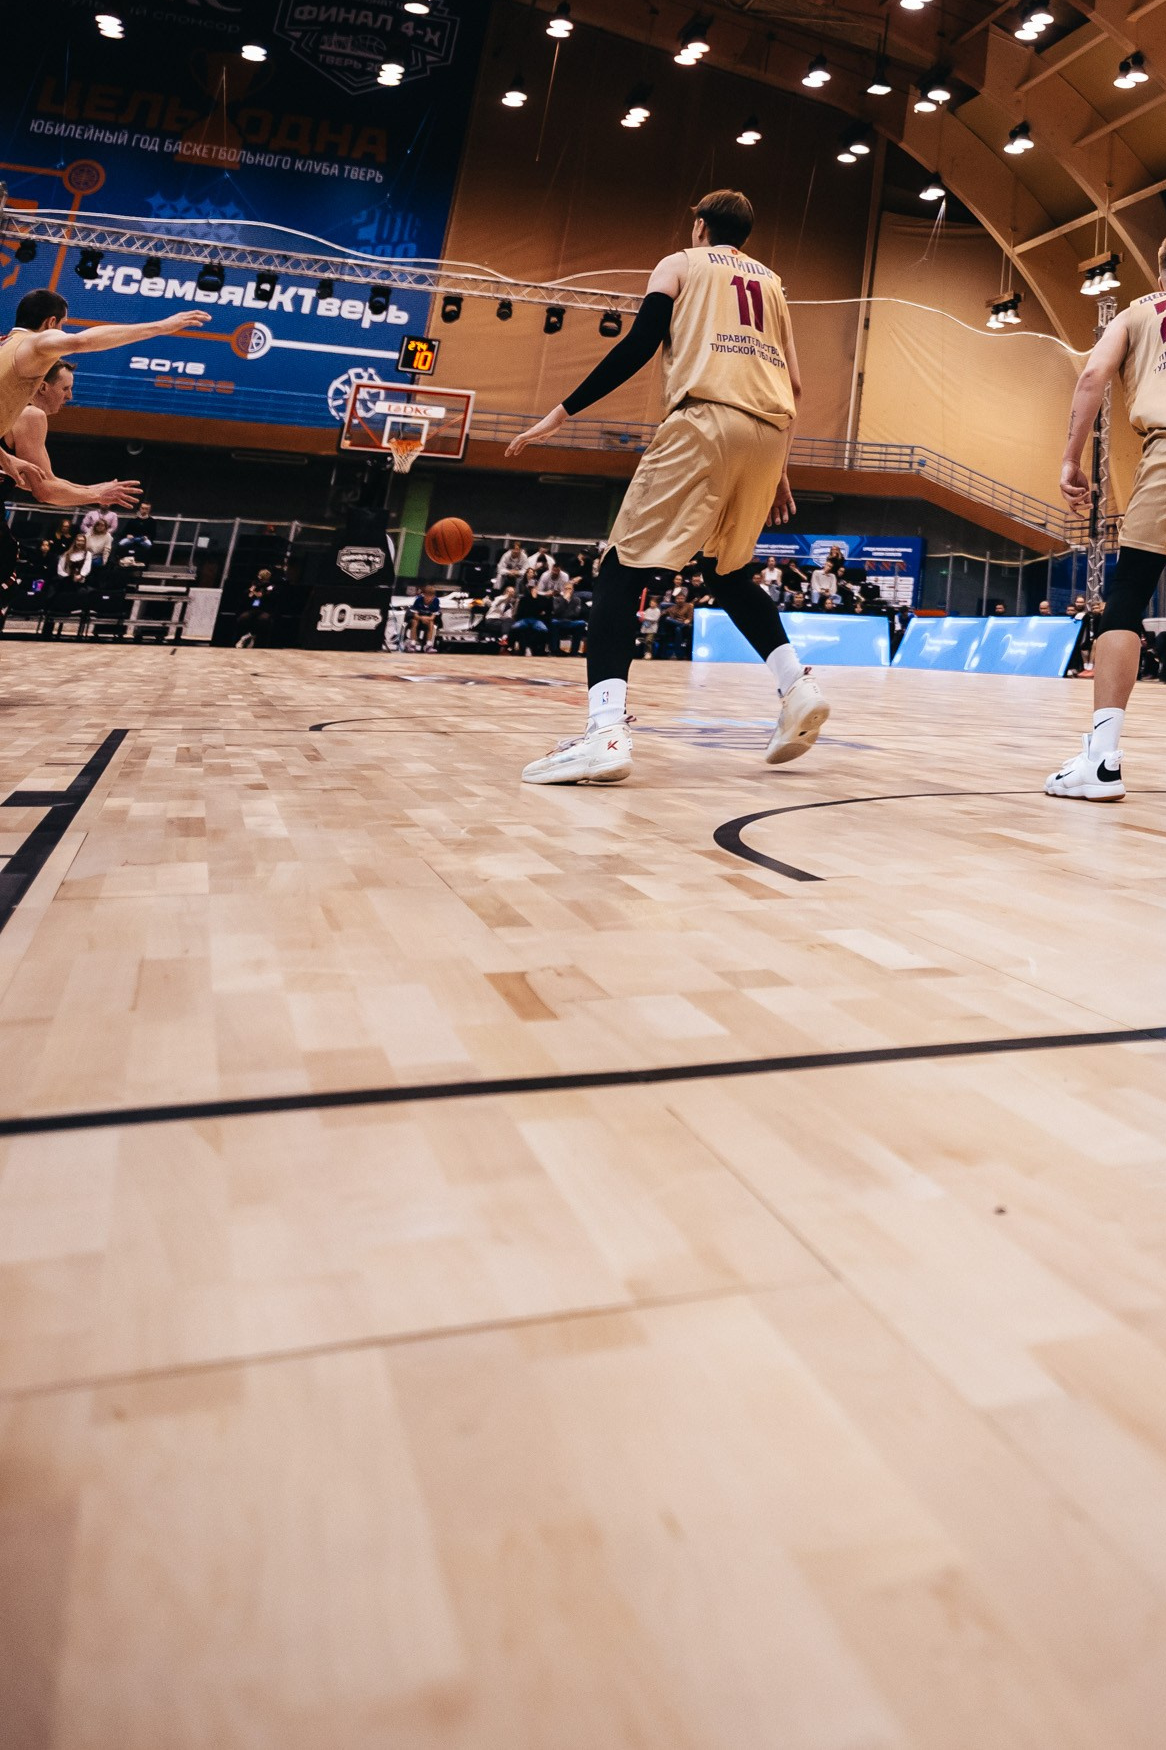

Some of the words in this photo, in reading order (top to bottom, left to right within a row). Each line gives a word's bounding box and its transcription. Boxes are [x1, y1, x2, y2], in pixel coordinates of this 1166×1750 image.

[294, 4, 394, 31] ФИНАЛ
[36, 74, 200, 132] ЦЕЛЬ
[237, 108, 388, 164] ОДНА
[29, 118, 129, 146] ЮБИЛЕЙНЫЙ
[131, 133, 160, 153] ГОД
[163, 139, 291, 170] БАСКЕТБОЛЬНОГО
[294, 158, 340, 178] КЛУБА
[343, 165, 384, 184] ТВЕРЬ
[708, 253, 773, 279] АНТИПОВ
[730, 275, 764, 333] 11
[710, 343, 756, 356] ТУЛЬСКОЙ
[716, 333, 780, 356] ПРАВИТЕЛЬСТВО
[413, 351, 434, 370] 10
